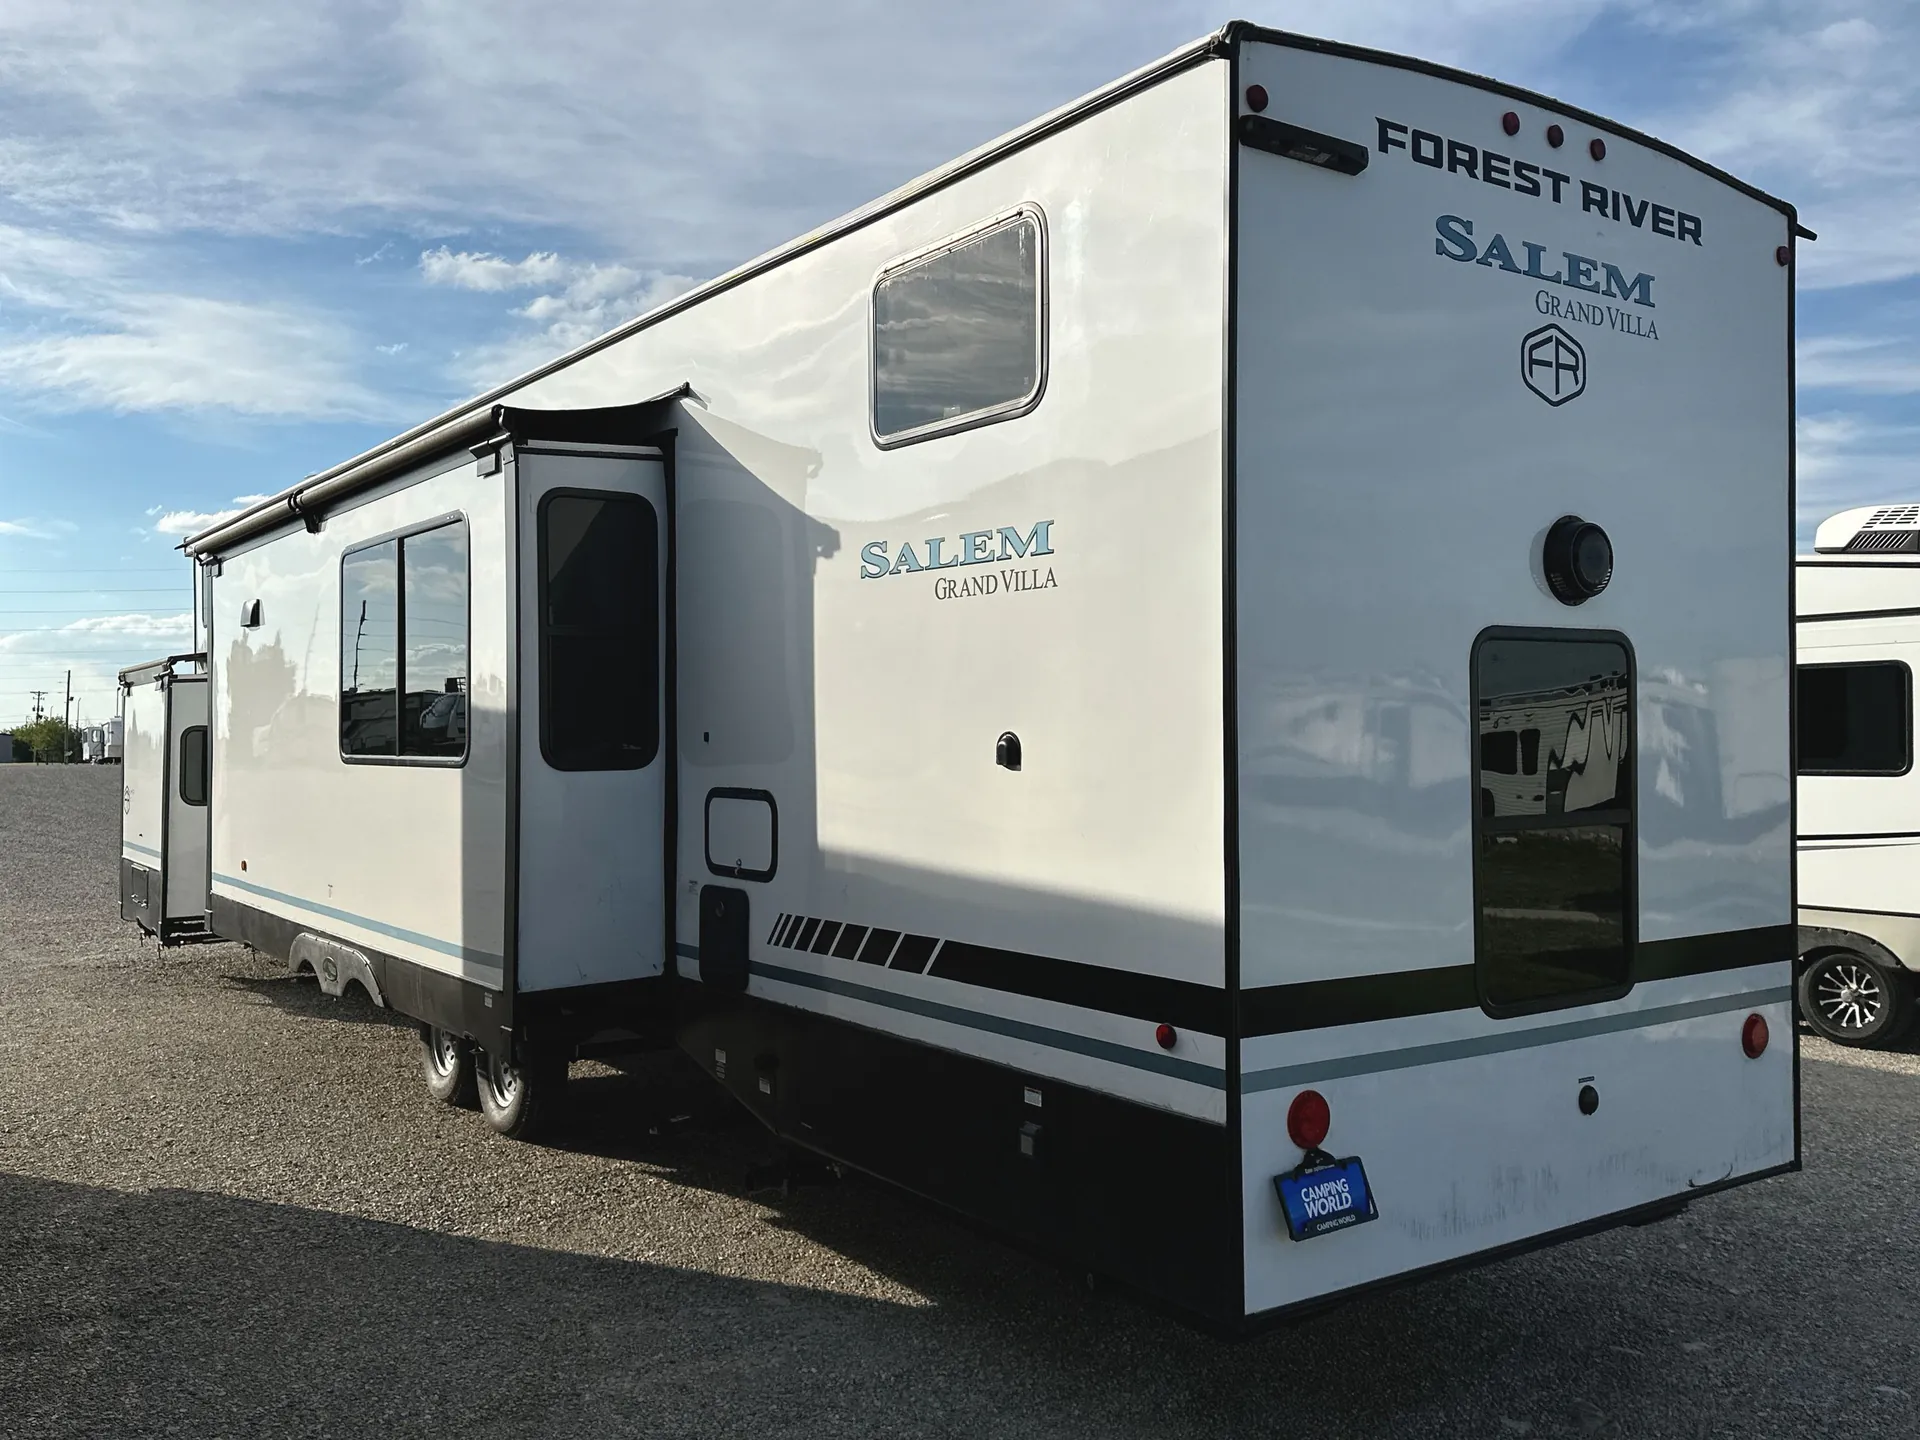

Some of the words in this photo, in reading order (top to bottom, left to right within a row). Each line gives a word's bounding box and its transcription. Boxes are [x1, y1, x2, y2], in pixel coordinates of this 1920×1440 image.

[1375, 116, 1570, 204] FOREST
[1579, 179, 1703, 247] RIVER
[1435, 214, 1656, 308] SALEM
[1535, 289, 1604, 327] GRAND
[1605, 305, 1660, 341] VILLA
[860, 519, 1055, 580] SALEM
[934, 573, 998, 600] GRAND
[999, 566, 1058, 593] VILLA
[1301, 1178, 1349, 1202] CAMPING
[1303, 1192, 1352, 1219] WORLD
[1316, 1218, 1339, 1232] CAMPING
[1338, 1214, 1356, 1226] WORLD
